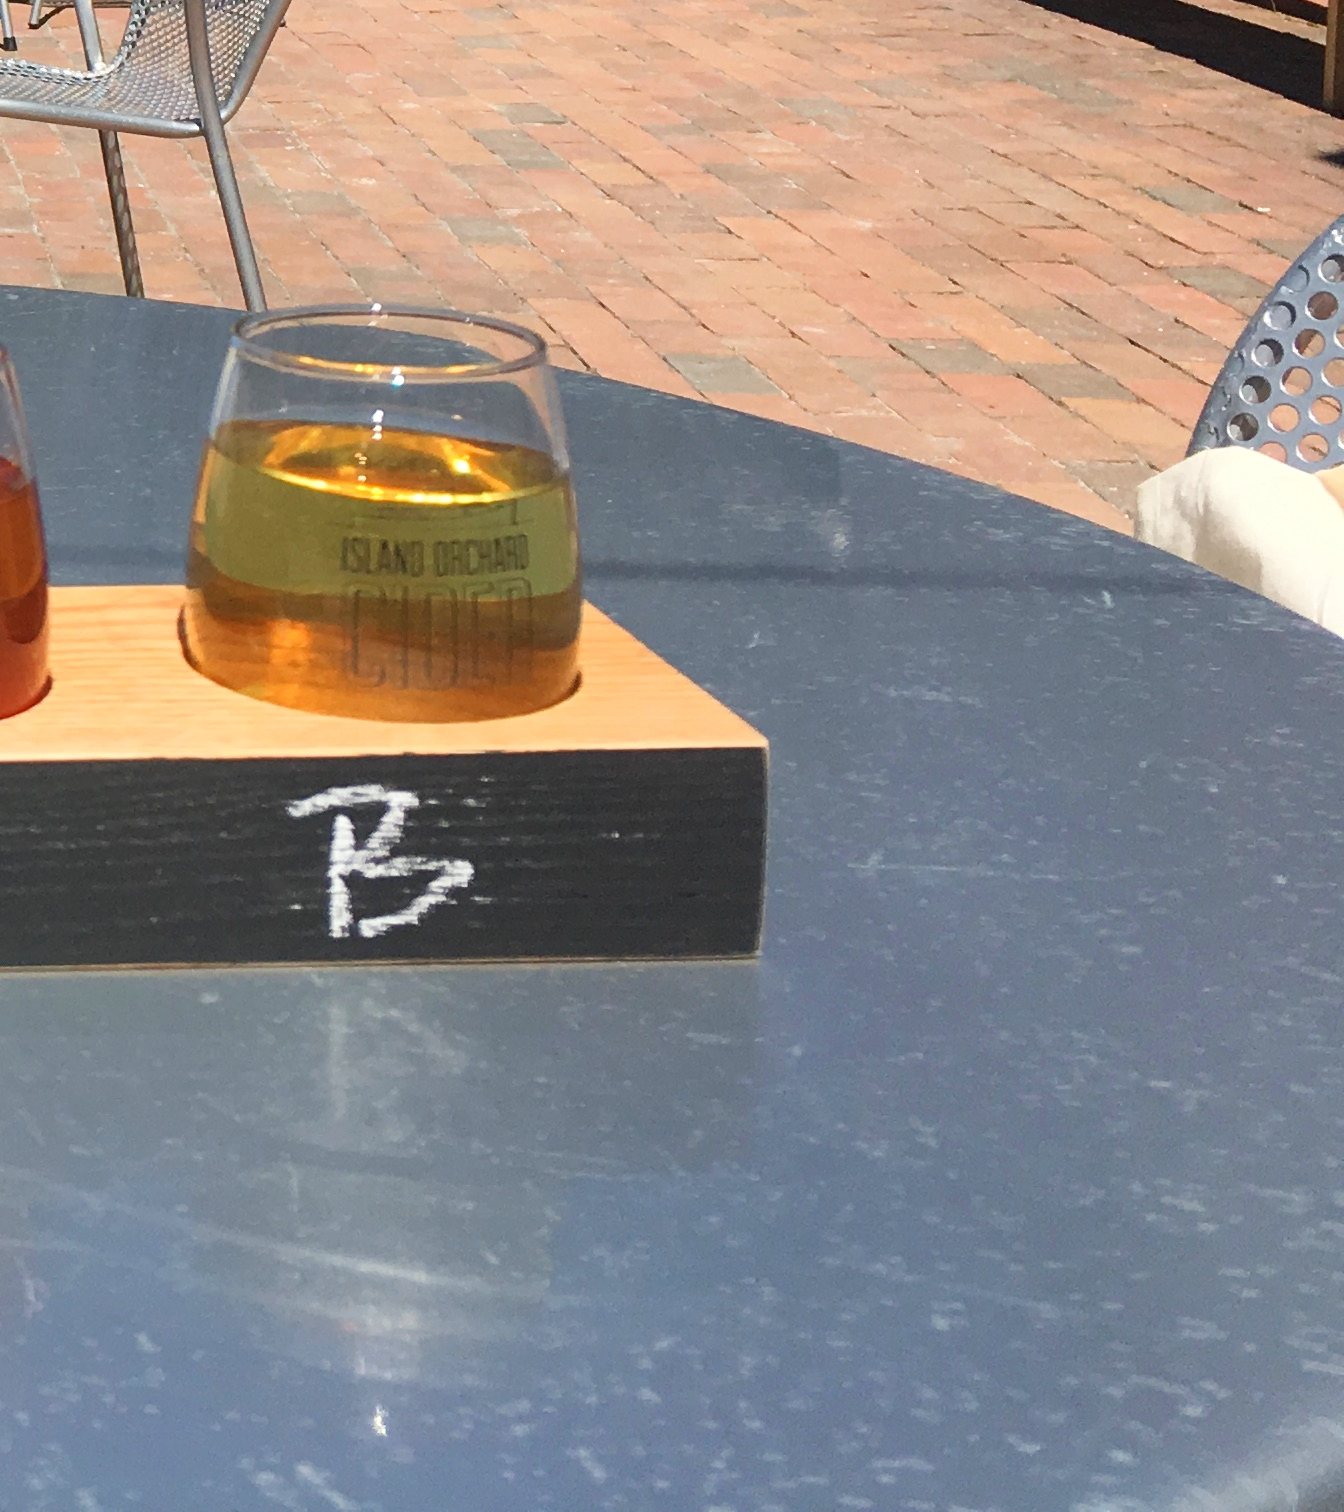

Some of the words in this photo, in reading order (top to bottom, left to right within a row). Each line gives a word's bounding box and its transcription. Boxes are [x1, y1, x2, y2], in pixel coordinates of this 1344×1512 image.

[340, 535, 425, 578] ISLAND
[432, 533, 530, 578] ORCHARD
[287, 784, 475, 938] B
